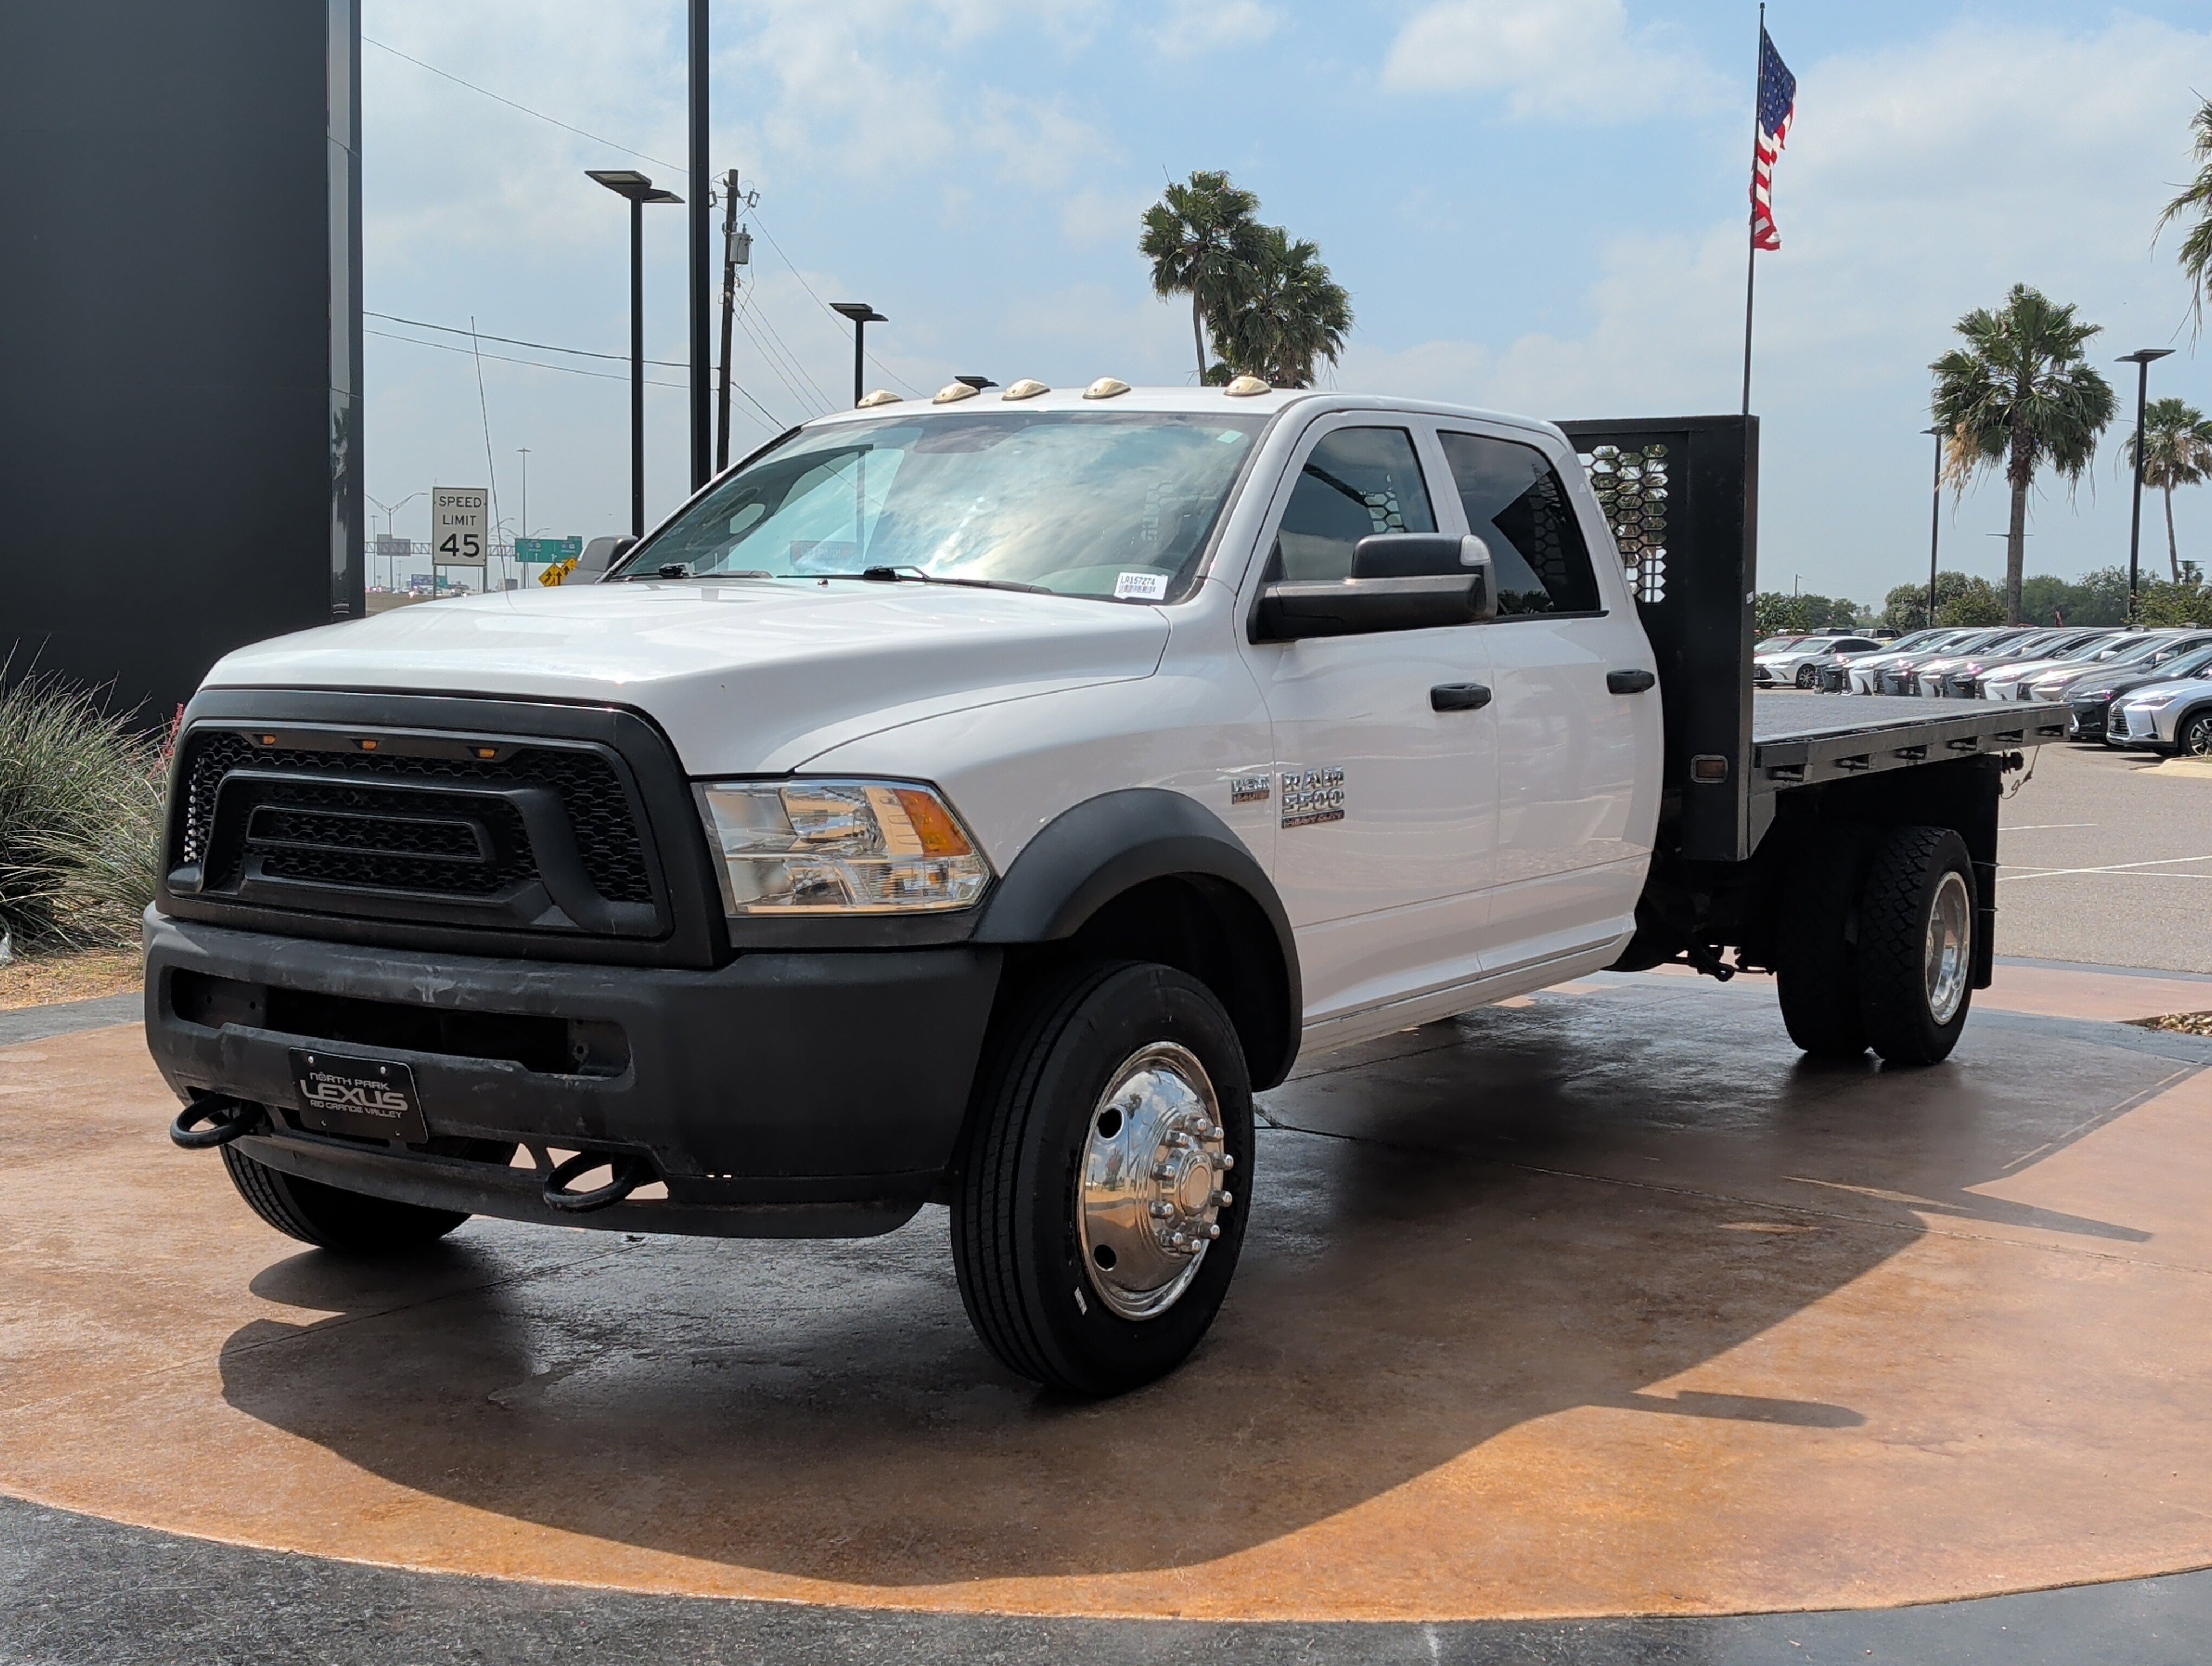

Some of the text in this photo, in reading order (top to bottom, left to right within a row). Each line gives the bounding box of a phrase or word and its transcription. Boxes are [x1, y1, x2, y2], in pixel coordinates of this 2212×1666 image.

[438, 496, 482, 508] SPEED
[442, 515, 477, 526] LIMIT
[439, 533, 480, 558] 45
[1282, 766, 1345, 792] RAM
[1282, 787, 1345, 814] 5500
[309, 1071, 390, 1091] NORTH PARK
[300, 1079, 408, 1111] LEXUS
[310, 1100, 402, 1119] RIO GRANDE VALLEY
